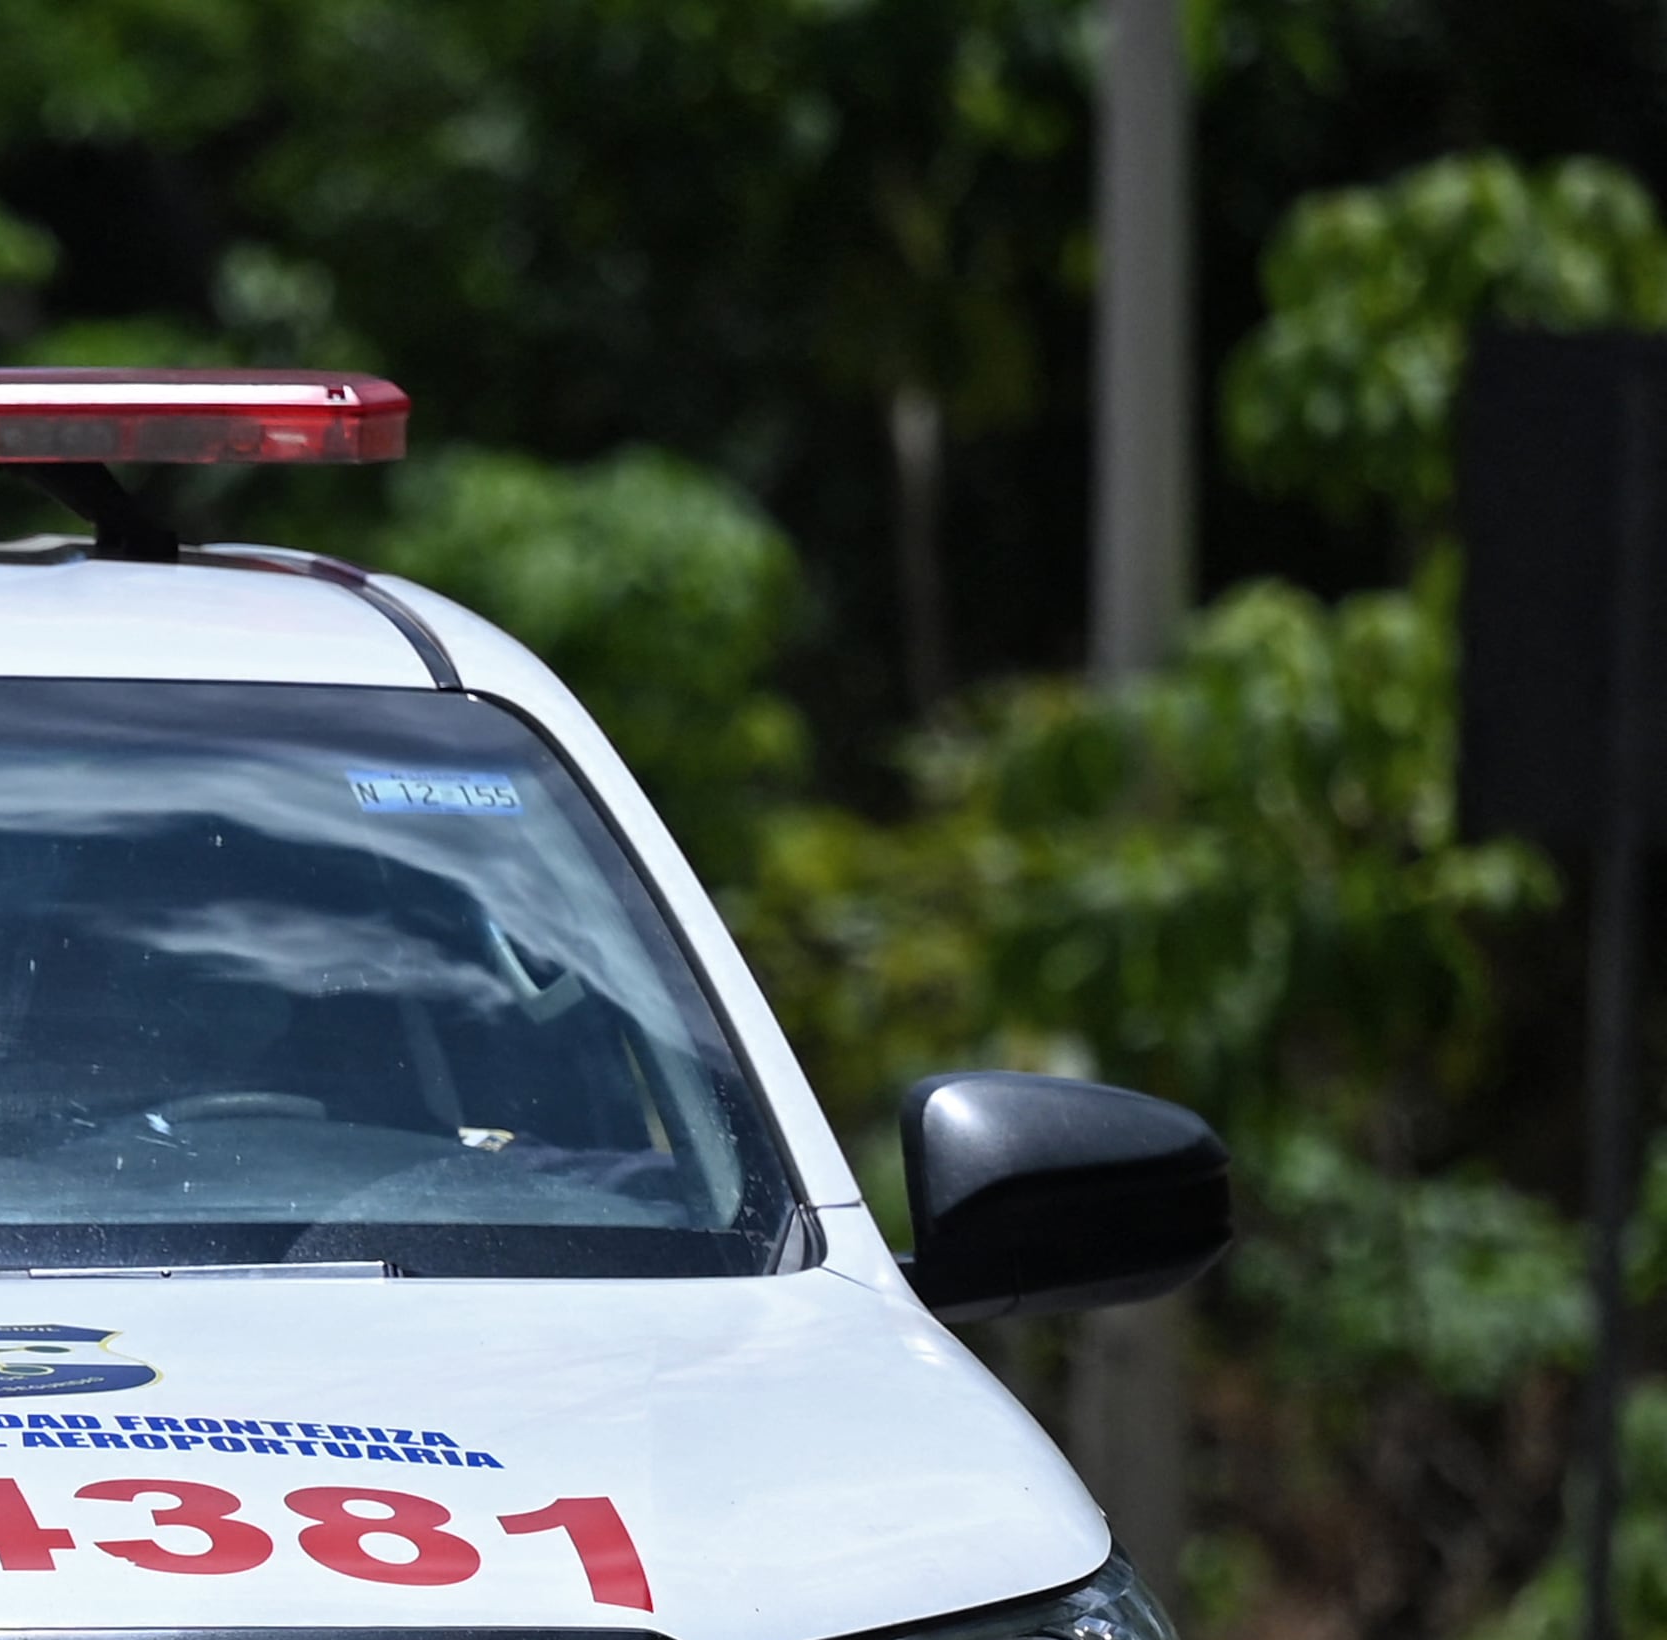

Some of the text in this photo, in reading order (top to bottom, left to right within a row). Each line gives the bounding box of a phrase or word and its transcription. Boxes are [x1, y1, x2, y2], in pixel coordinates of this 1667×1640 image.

[356, 782, 517, 809] N 12 155
[115, 1415, 460, 1449] FRONTERIZA
[21, 1431, 506, 1469] AEROPORTUARIA
